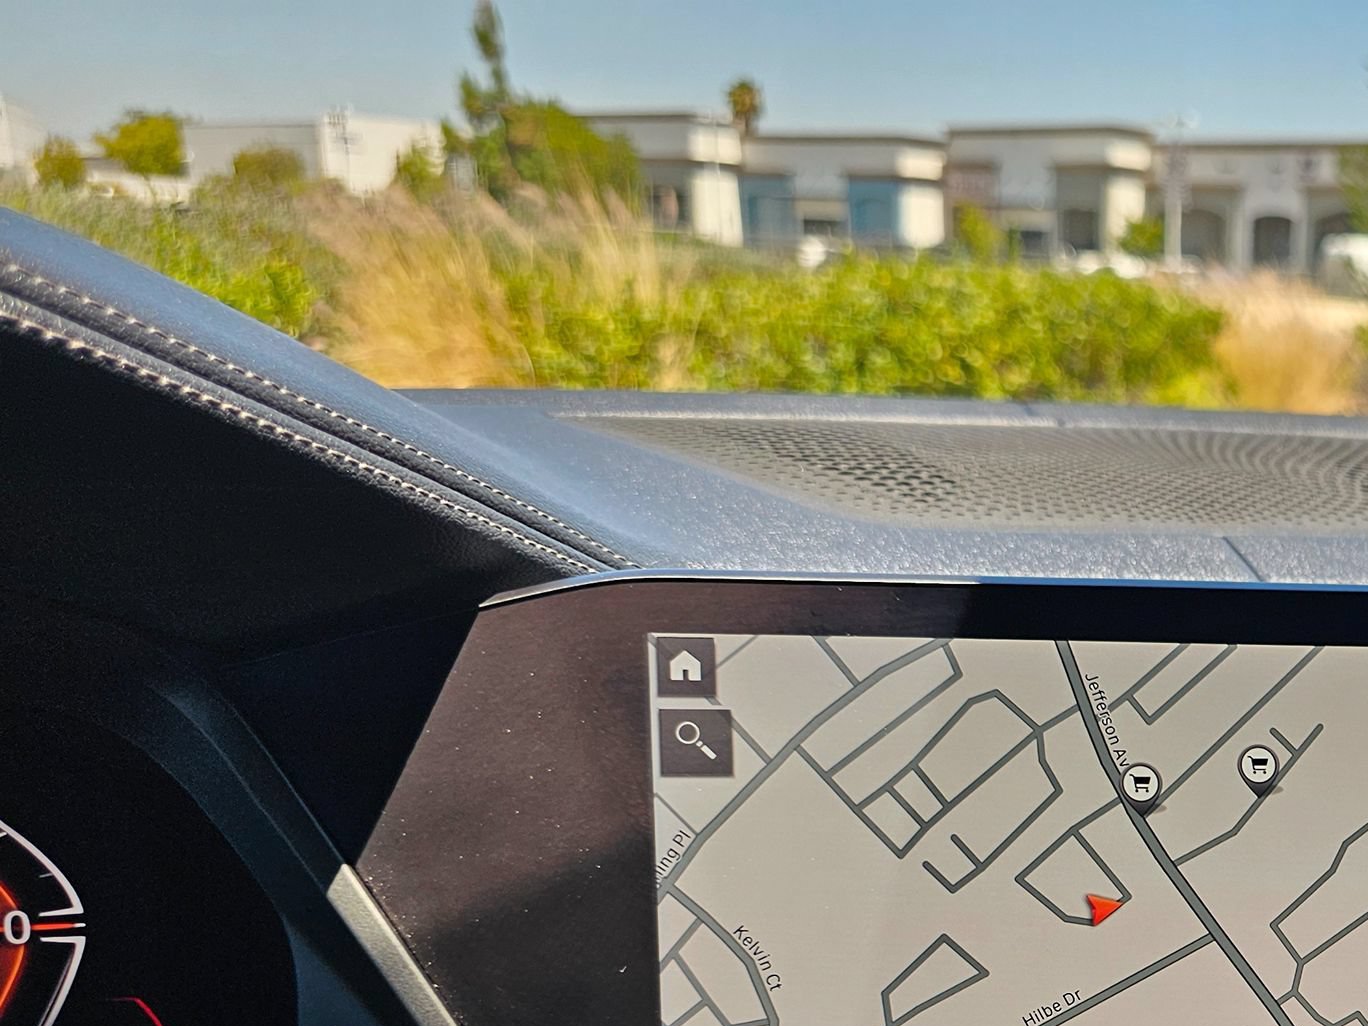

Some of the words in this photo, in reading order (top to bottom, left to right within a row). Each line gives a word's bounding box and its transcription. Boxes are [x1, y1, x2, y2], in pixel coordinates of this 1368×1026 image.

[1085, 673, 1119, 746] Jefferson
[672, 830, 692, 847] Pl
[4, 910, 31, 945] 0
[733, 925, 772, 971] Kelvin
[766, 974, 782, 991] Ct
[1063, 990, 1081, 1006] Dr
